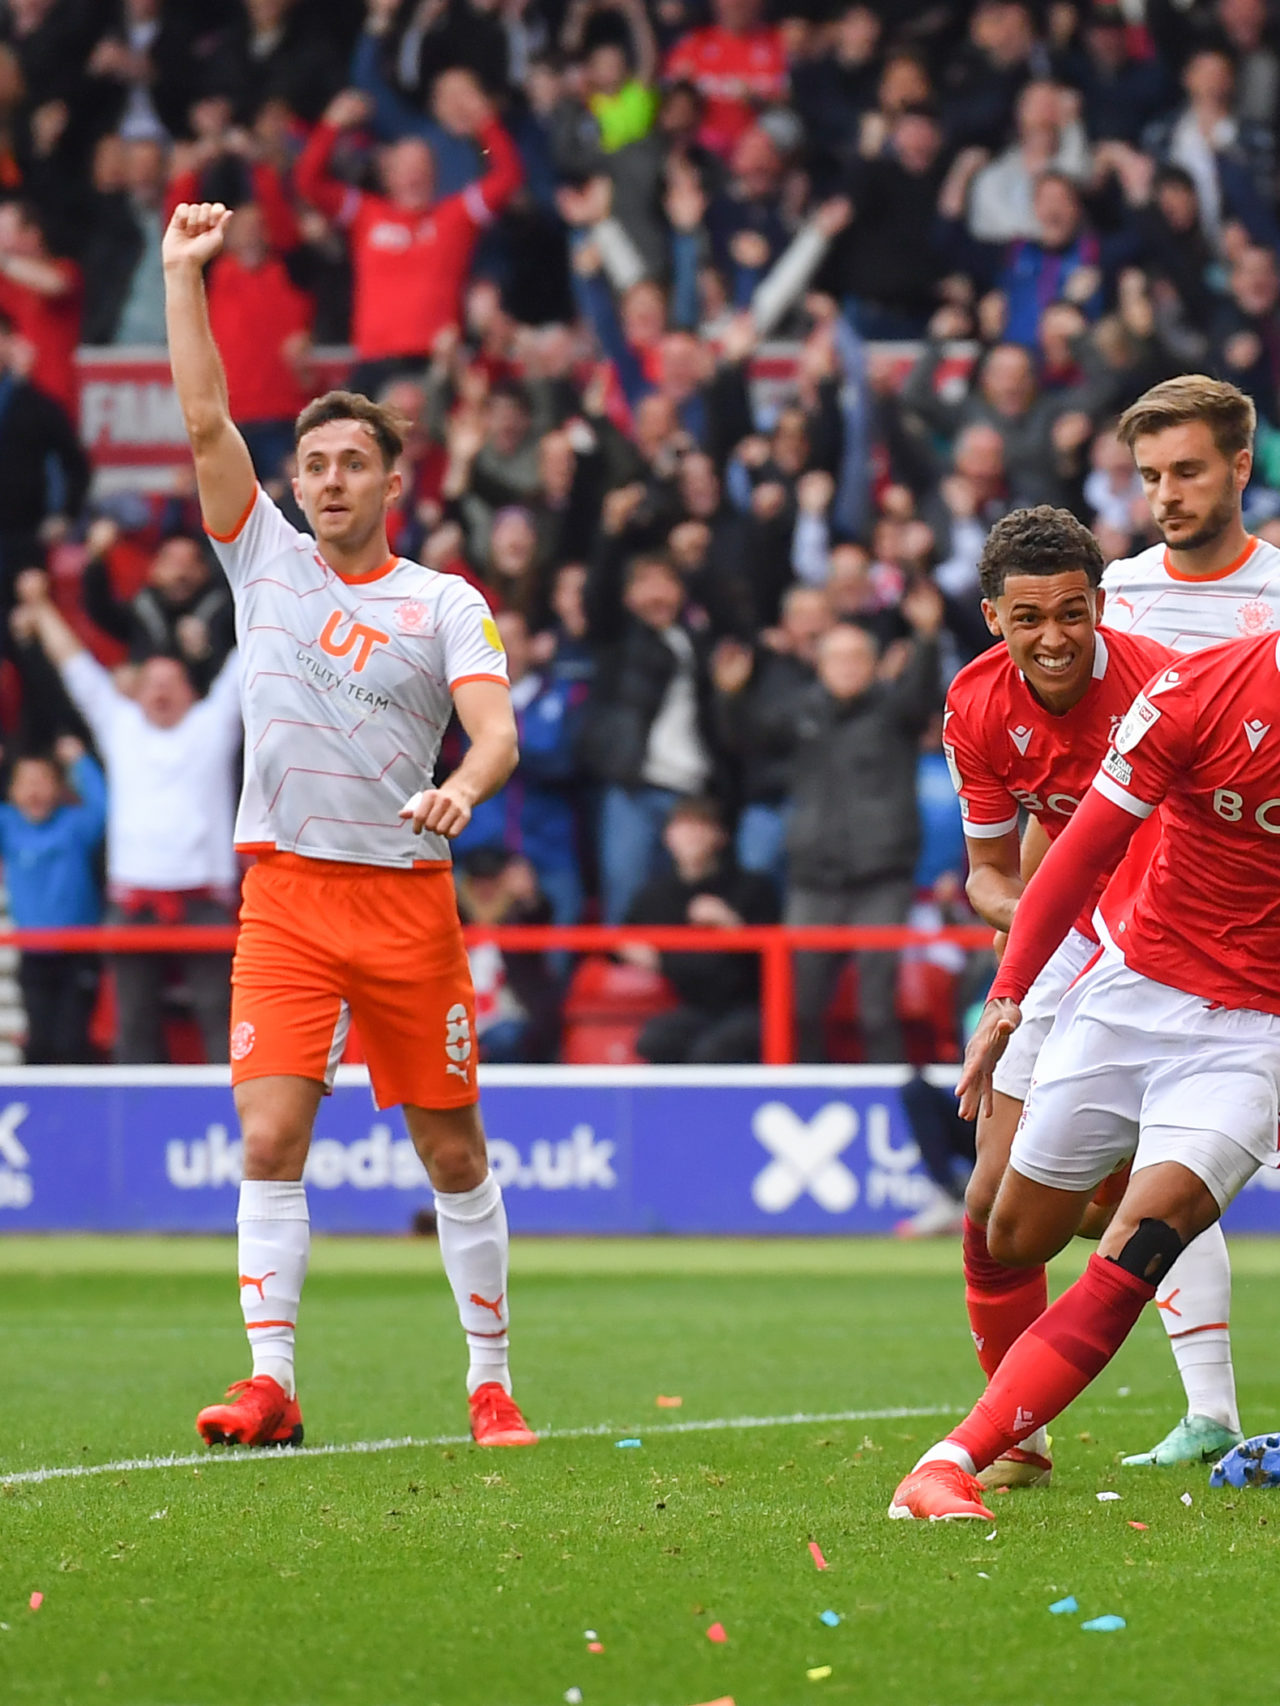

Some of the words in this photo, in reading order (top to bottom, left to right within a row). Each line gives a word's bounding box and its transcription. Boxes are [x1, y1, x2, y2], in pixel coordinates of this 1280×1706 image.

[319, 610, 389, 673] UT
[296, 650, 344, 689] UTILITY
[348, 683, 389, 711] TEAM
[1010, 789, 1081, 817] BO
[445, 1003, 471, 1061] 8
